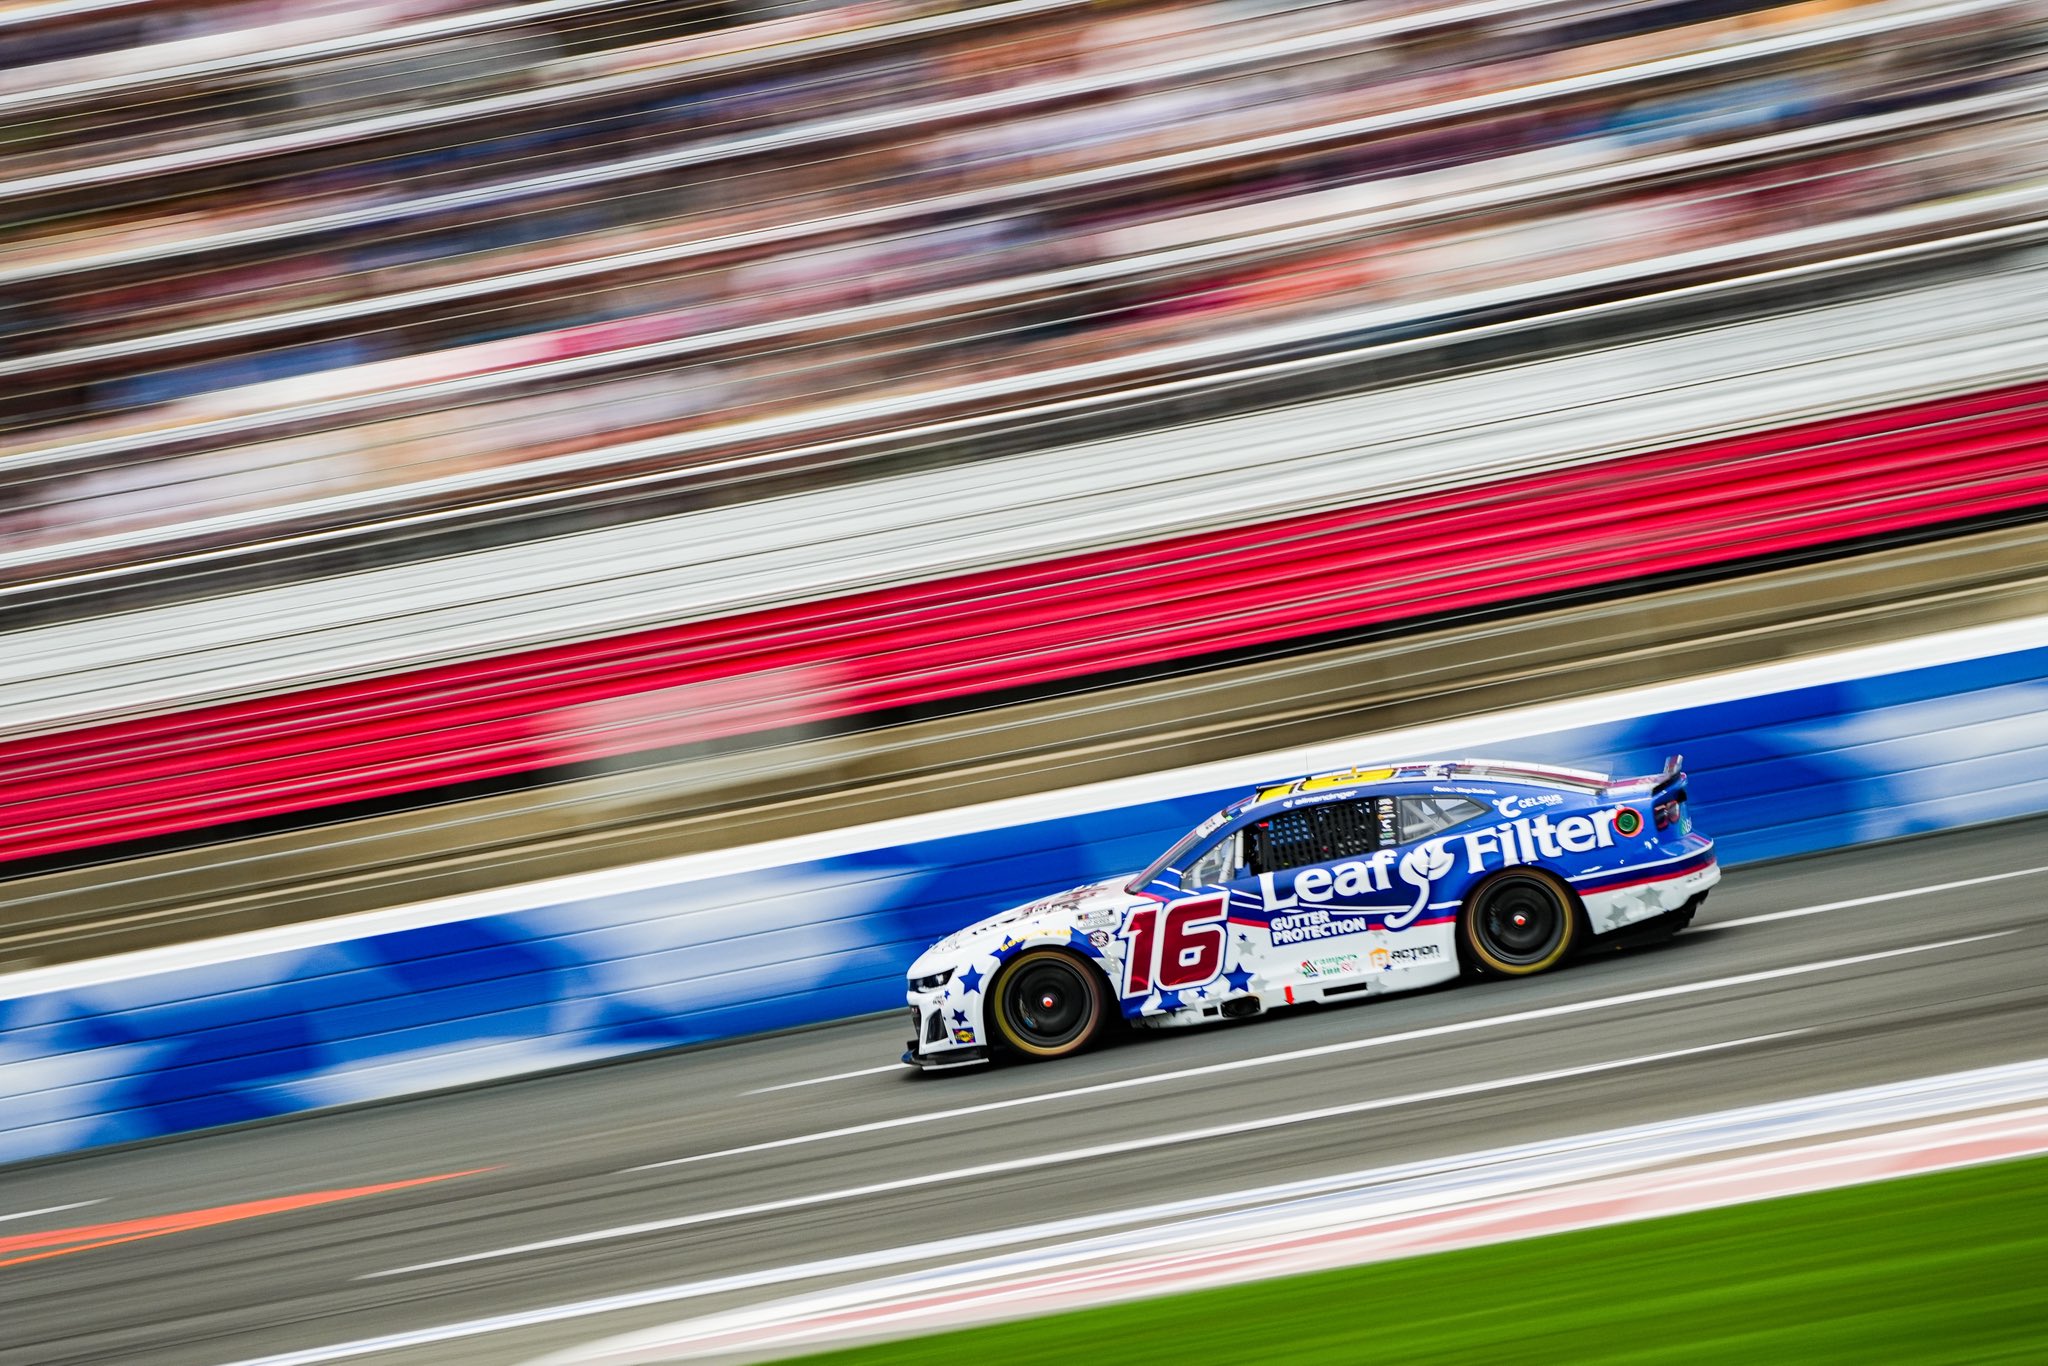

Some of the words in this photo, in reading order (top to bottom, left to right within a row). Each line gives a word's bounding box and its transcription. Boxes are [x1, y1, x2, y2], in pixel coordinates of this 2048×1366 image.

[1518, 794, 1564, 809] CELSIUS
[1258, 849, 1398, 912] Leaf
[1463, 809, 1618, 874] Filter
[1270, 909, 1331, 932] GUTTER
[1272, 917, 1368, 946] PROTECTION
[1119, 891, 1230, 998] 16
[1390, 944, 1440, 961] ACTION
